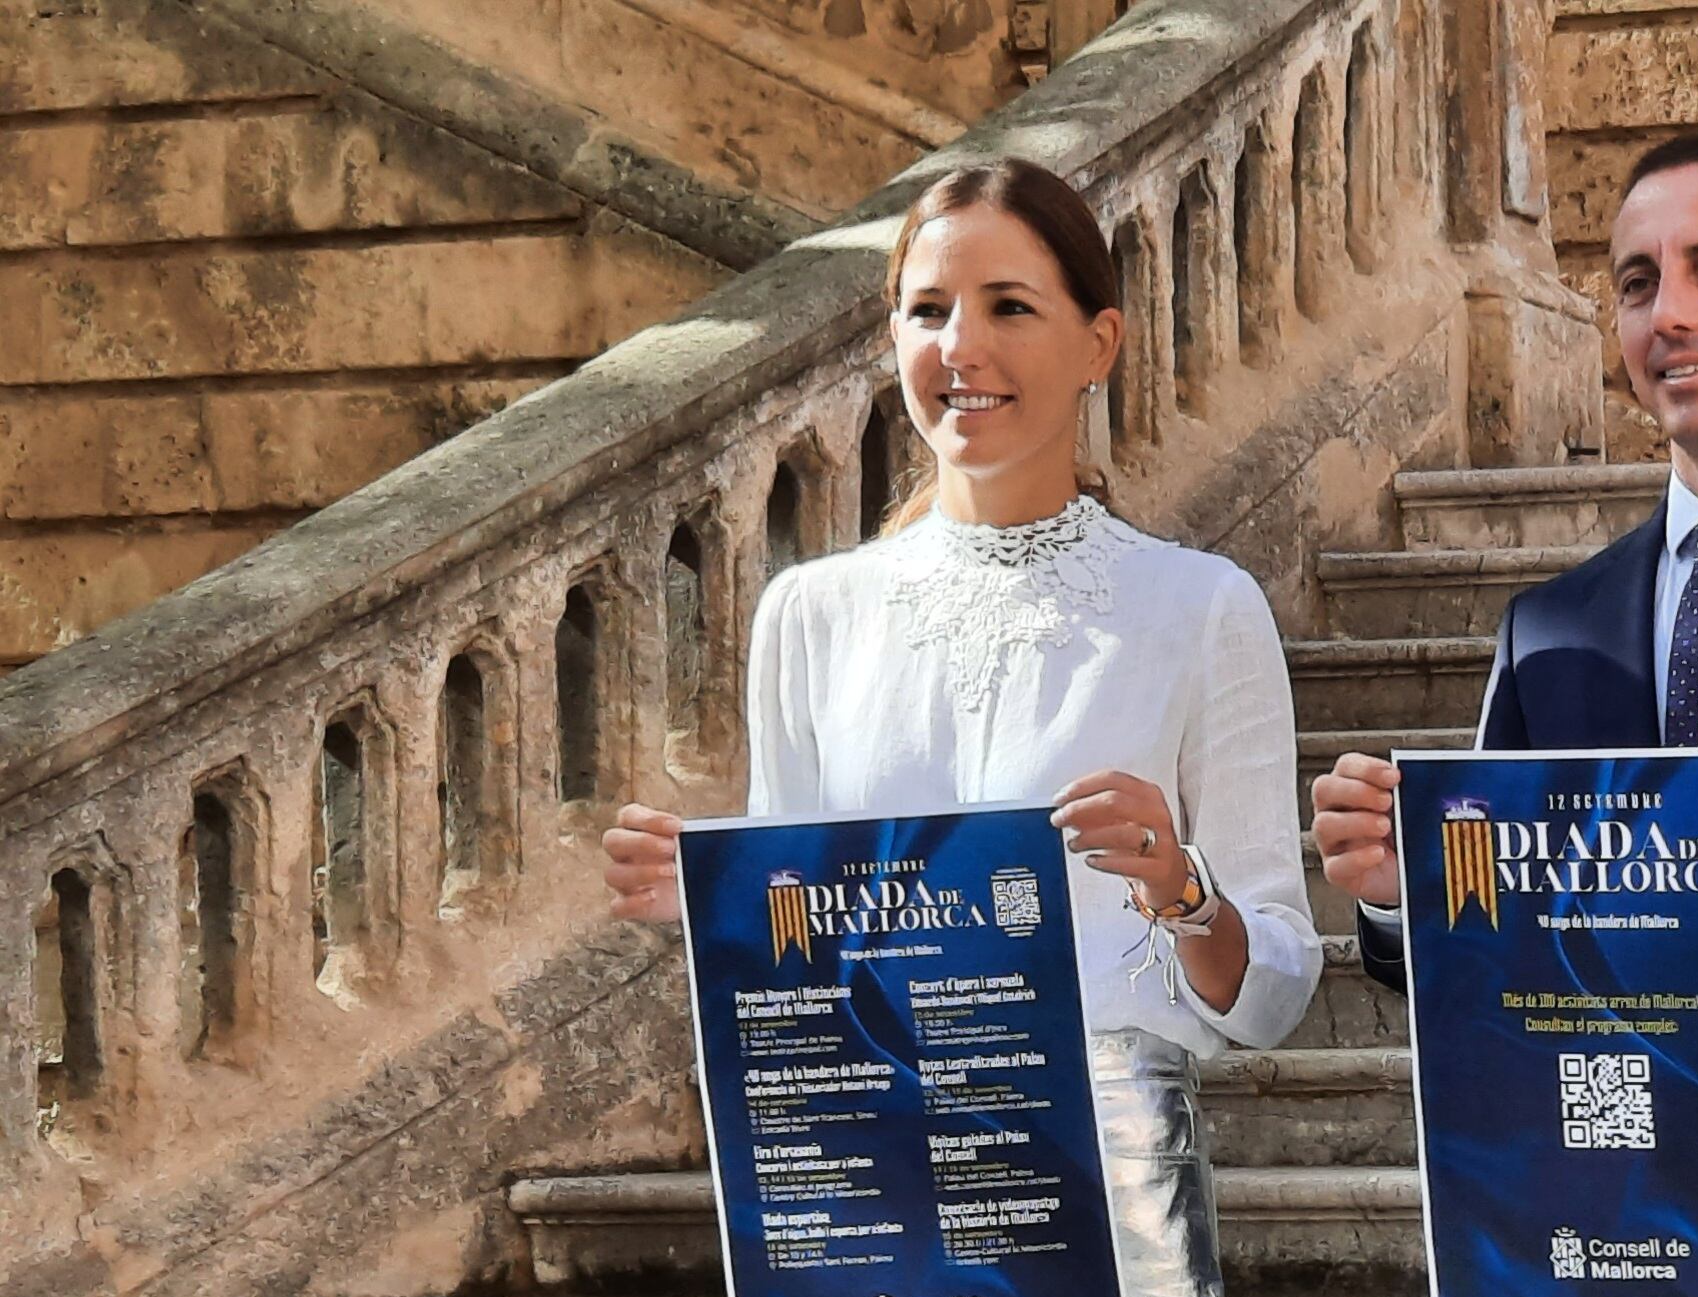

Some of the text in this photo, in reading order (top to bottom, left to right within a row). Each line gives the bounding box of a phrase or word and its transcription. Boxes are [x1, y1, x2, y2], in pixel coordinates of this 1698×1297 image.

[1549, 793, 1662, 810] 12 SETEMBRE
[1495, 821, 1675, 860] DIADA
[808, 879, 963, 913] DIADA DE
[809, 905, 987, 936] MALLORCA
[1589, 1239, 1690, 1257] Consell de
[1591, 1261, 1677, 1279] Mallorca
